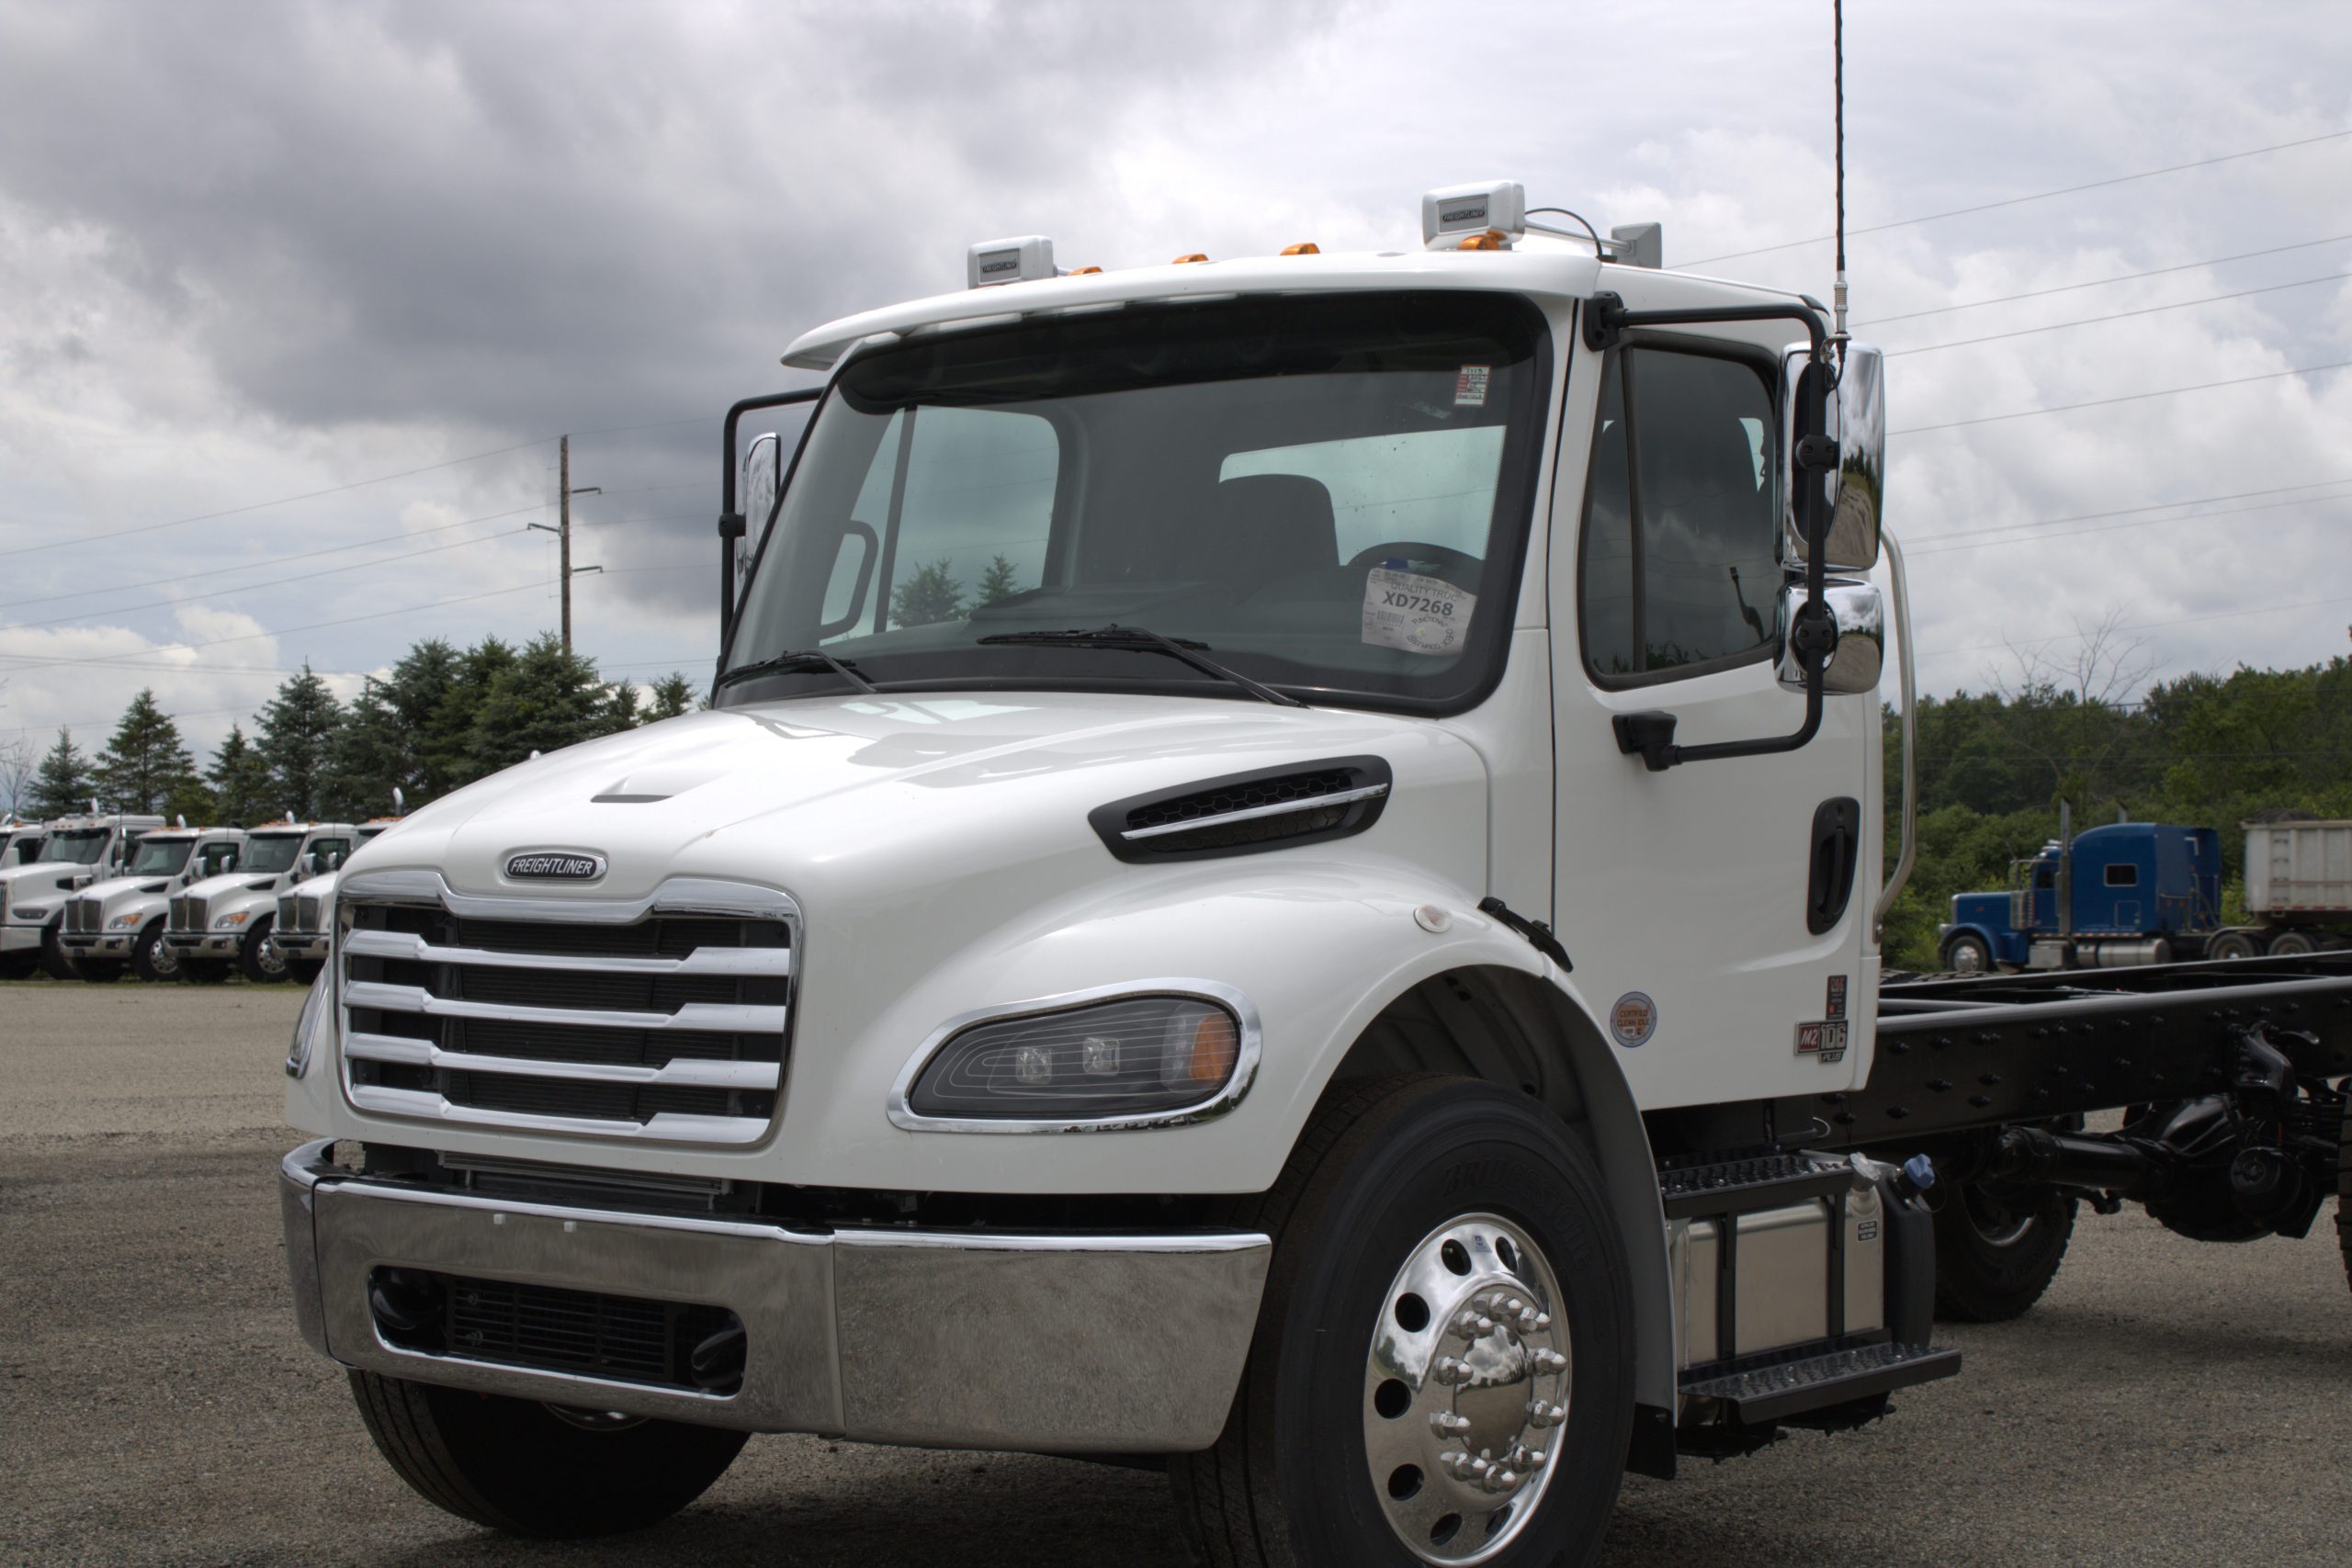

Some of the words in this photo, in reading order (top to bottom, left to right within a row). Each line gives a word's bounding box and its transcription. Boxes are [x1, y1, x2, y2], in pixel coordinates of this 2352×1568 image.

[1391, 581, 1430, 595] QUALITY
[1383, 591, 1453, 616] XD7268
[511, 858, 593, 874] FREIGHTLINER
[1801, 1029, 1818, 1046] M2
[1821, 1023, 1847, 1050] 106
[1823, 1052, 1842, 1062] PLUS
